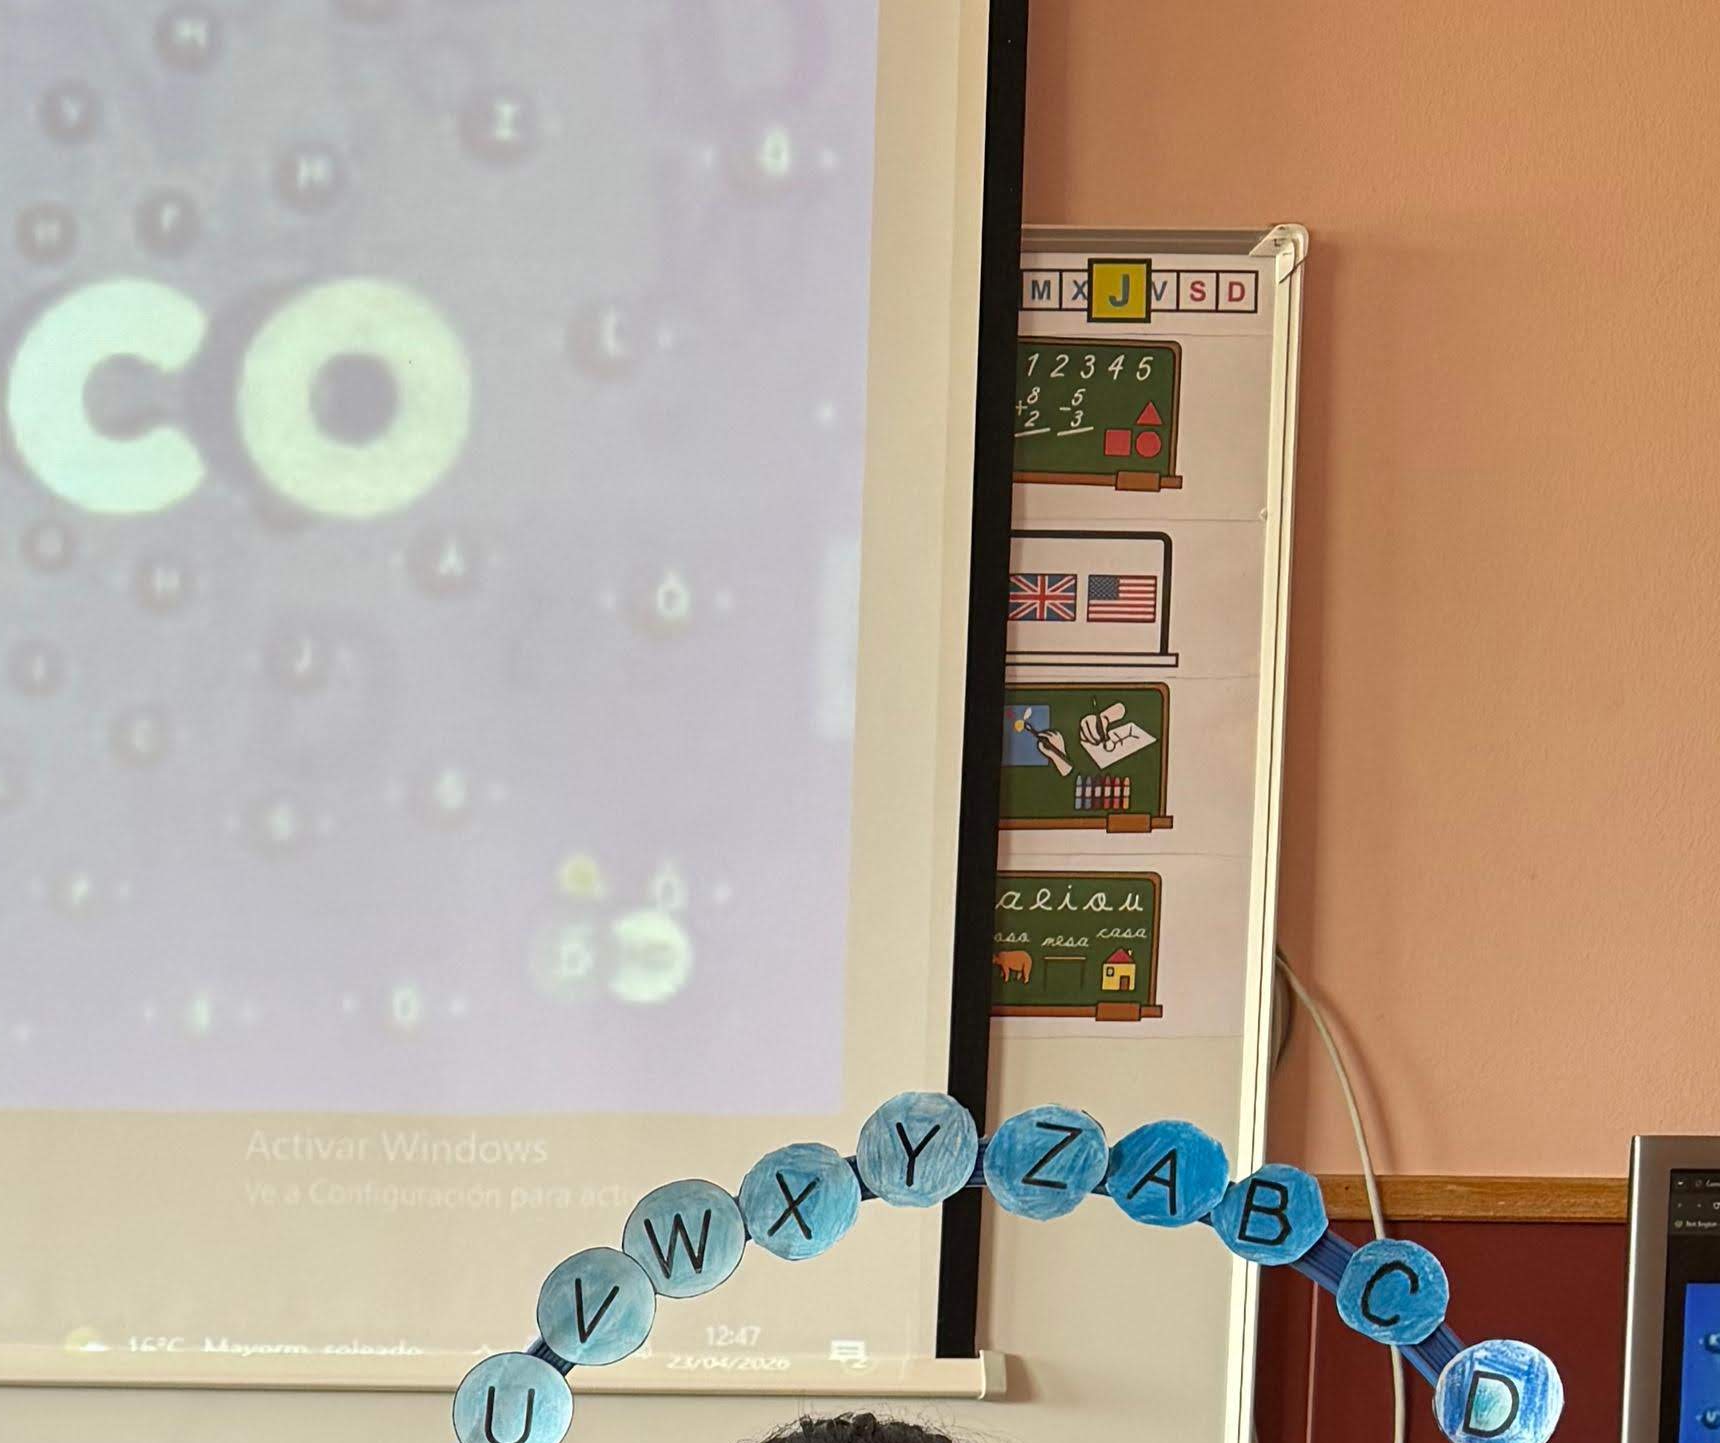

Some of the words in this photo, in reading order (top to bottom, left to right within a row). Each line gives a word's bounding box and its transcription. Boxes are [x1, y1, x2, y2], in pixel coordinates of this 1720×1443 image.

[1030, 279, 1052, 300] M
[1072, 280, 1089, 301] X
[1108, 272, 1131, 308] J
[1150, 281, 1168, 302] V
[1189, 280, 1207, 302] S
[1227, 280, 1246, 302] D
[1026, 353, 1040, 377] 1
[1049, 353, 1070, 379] 2
[1080, 354, 1097, 380] 3
[1107, 353, 1126, 380] 4
[1135, 355, 1154, 381] 5
[1041, 935, 1090, 948] mesa
[1096, 926, 1148, 939] casa
[245, 1129, 368, 1162] Activar
[381, 1130, 550, 1165] Windows
[896, 1123, 940, 1186] Y
[1022, 1122, 1082, 1189] Z
[768, 1172, 816, 1239] X
[1128, 1149, 1178, 1217] A
[1239, 1180, 1291, 1245] B
[644, 1210, 711, 1278] W
[575, 1278, 619, 1343] V
[1361, 1261, 1418, 1326] C
[665, 1356, 792, 1371] 23/04/2026
[705, 1325, 761, 1347] 12:47
[1463, 1371, 1519, 1438] D
